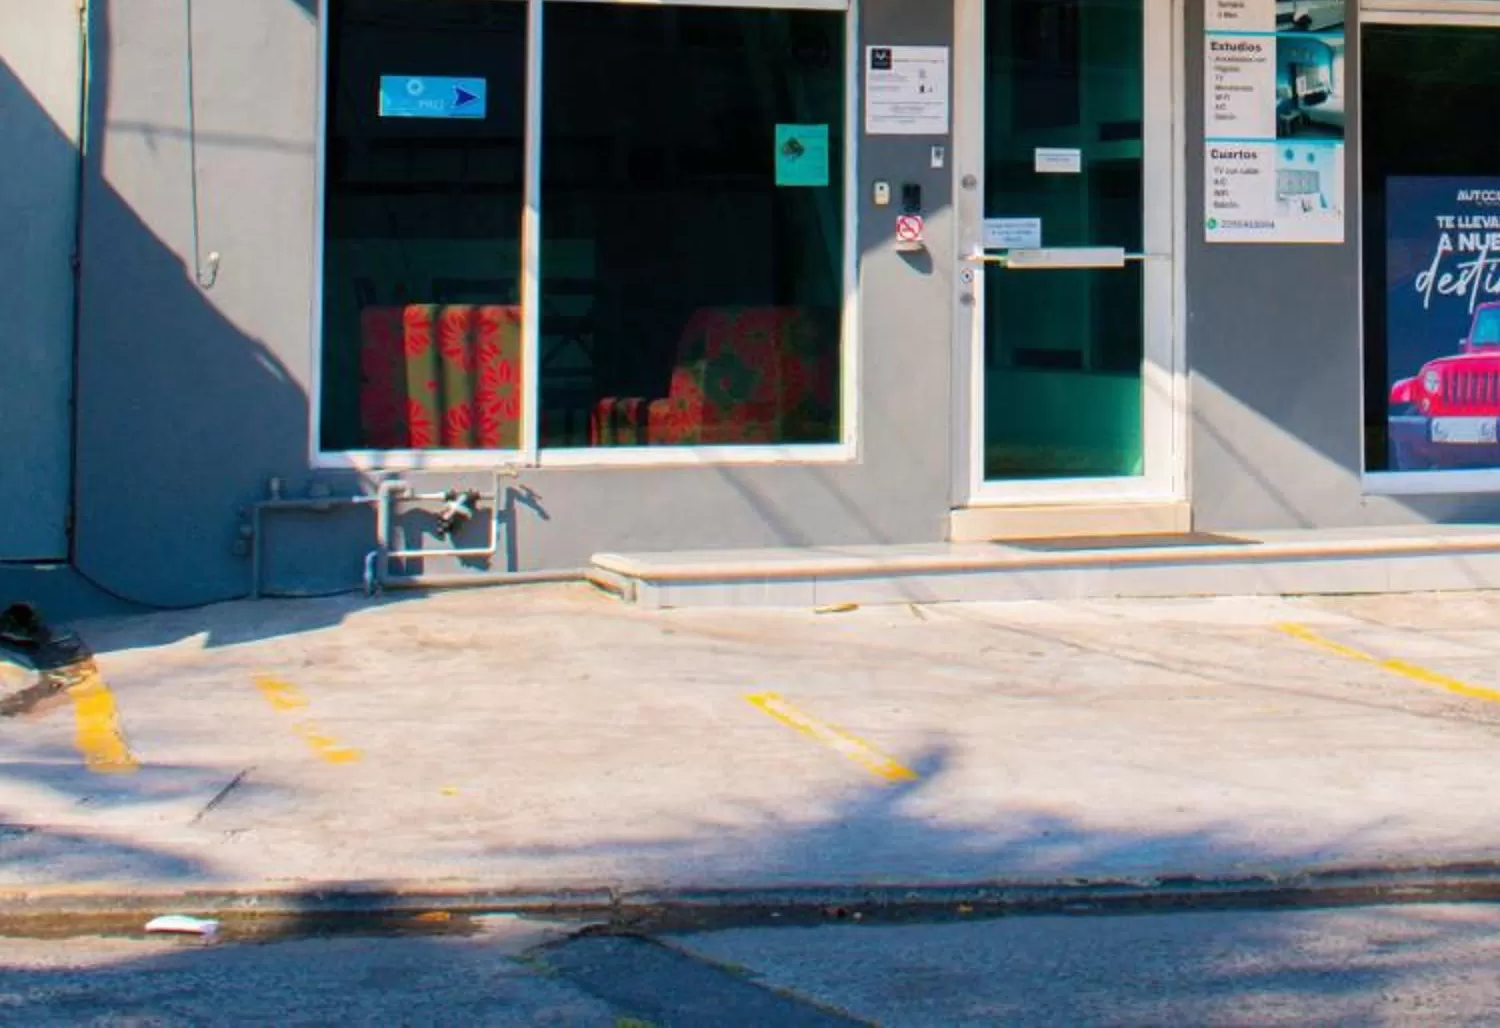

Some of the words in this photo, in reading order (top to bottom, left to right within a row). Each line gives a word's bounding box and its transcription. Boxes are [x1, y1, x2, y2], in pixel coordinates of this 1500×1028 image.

[1210, 41, 1263, 52] Estudios
[1210, 148, 1258, 160] Cuartos
[1436, 216, 1454, 229] TE
[1439, 233, 1453, 252] A
